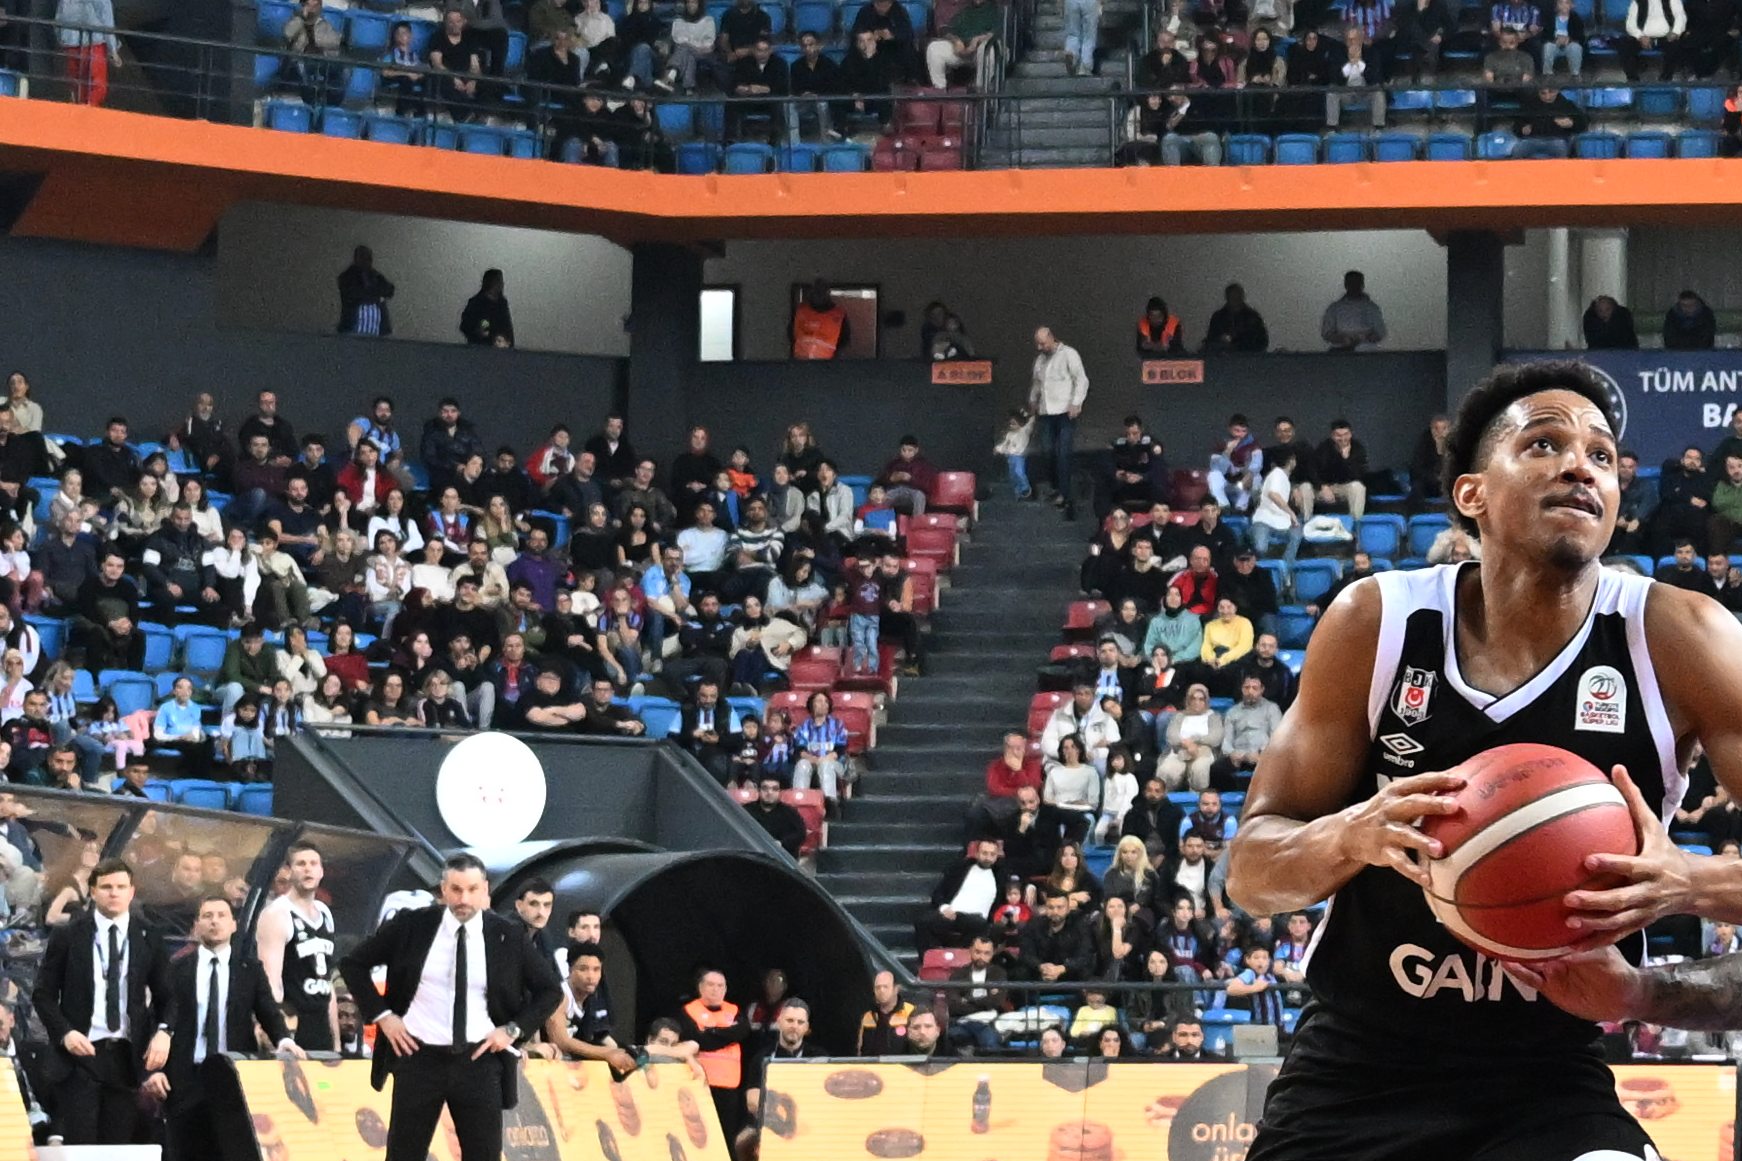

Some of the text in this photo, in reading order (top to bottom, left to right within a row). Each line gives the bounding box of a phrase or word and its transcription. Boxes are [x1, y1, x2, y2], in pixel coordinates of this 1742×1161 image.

[1638, 367, 1694, 393] TÜM
[1383, 751, 1415, 768] umbro
[1191, 1111, 1258, 1142] onla
